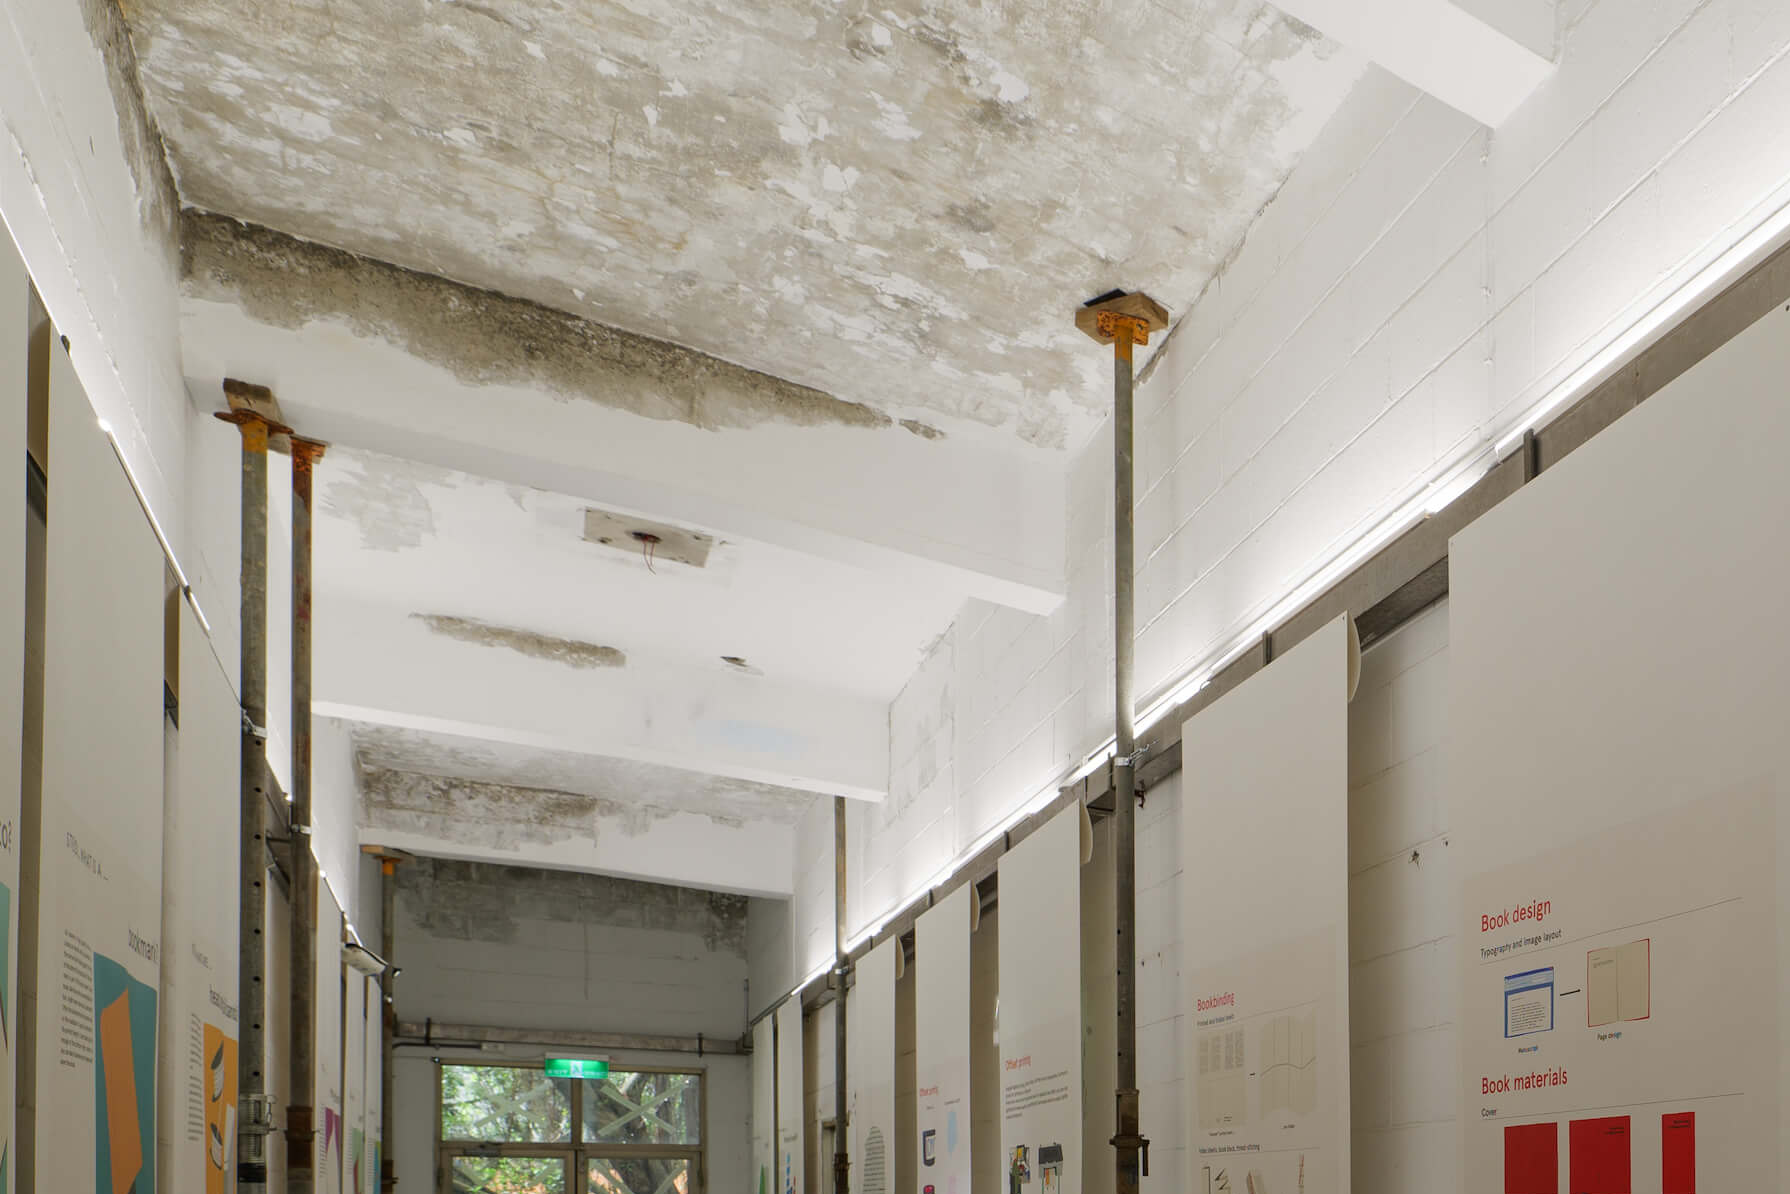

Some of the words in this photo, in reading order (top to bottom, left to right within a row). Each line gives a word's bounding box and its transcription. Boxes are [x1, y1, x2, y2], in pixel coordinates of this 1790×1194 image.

[1481, 908, 1510, 933] Book
[1512, 899, 1551, 922] design
[1480, 943, 1512, 959] Typography
[1523, 934, 1542, 947] image
[1543, 928, 1562, 943] layout
[1481, 1073, 1510, 1095] Book
[1513, 1066, 1569, 1089] materials
[1481, 1107, 1497, 1118] Cover
